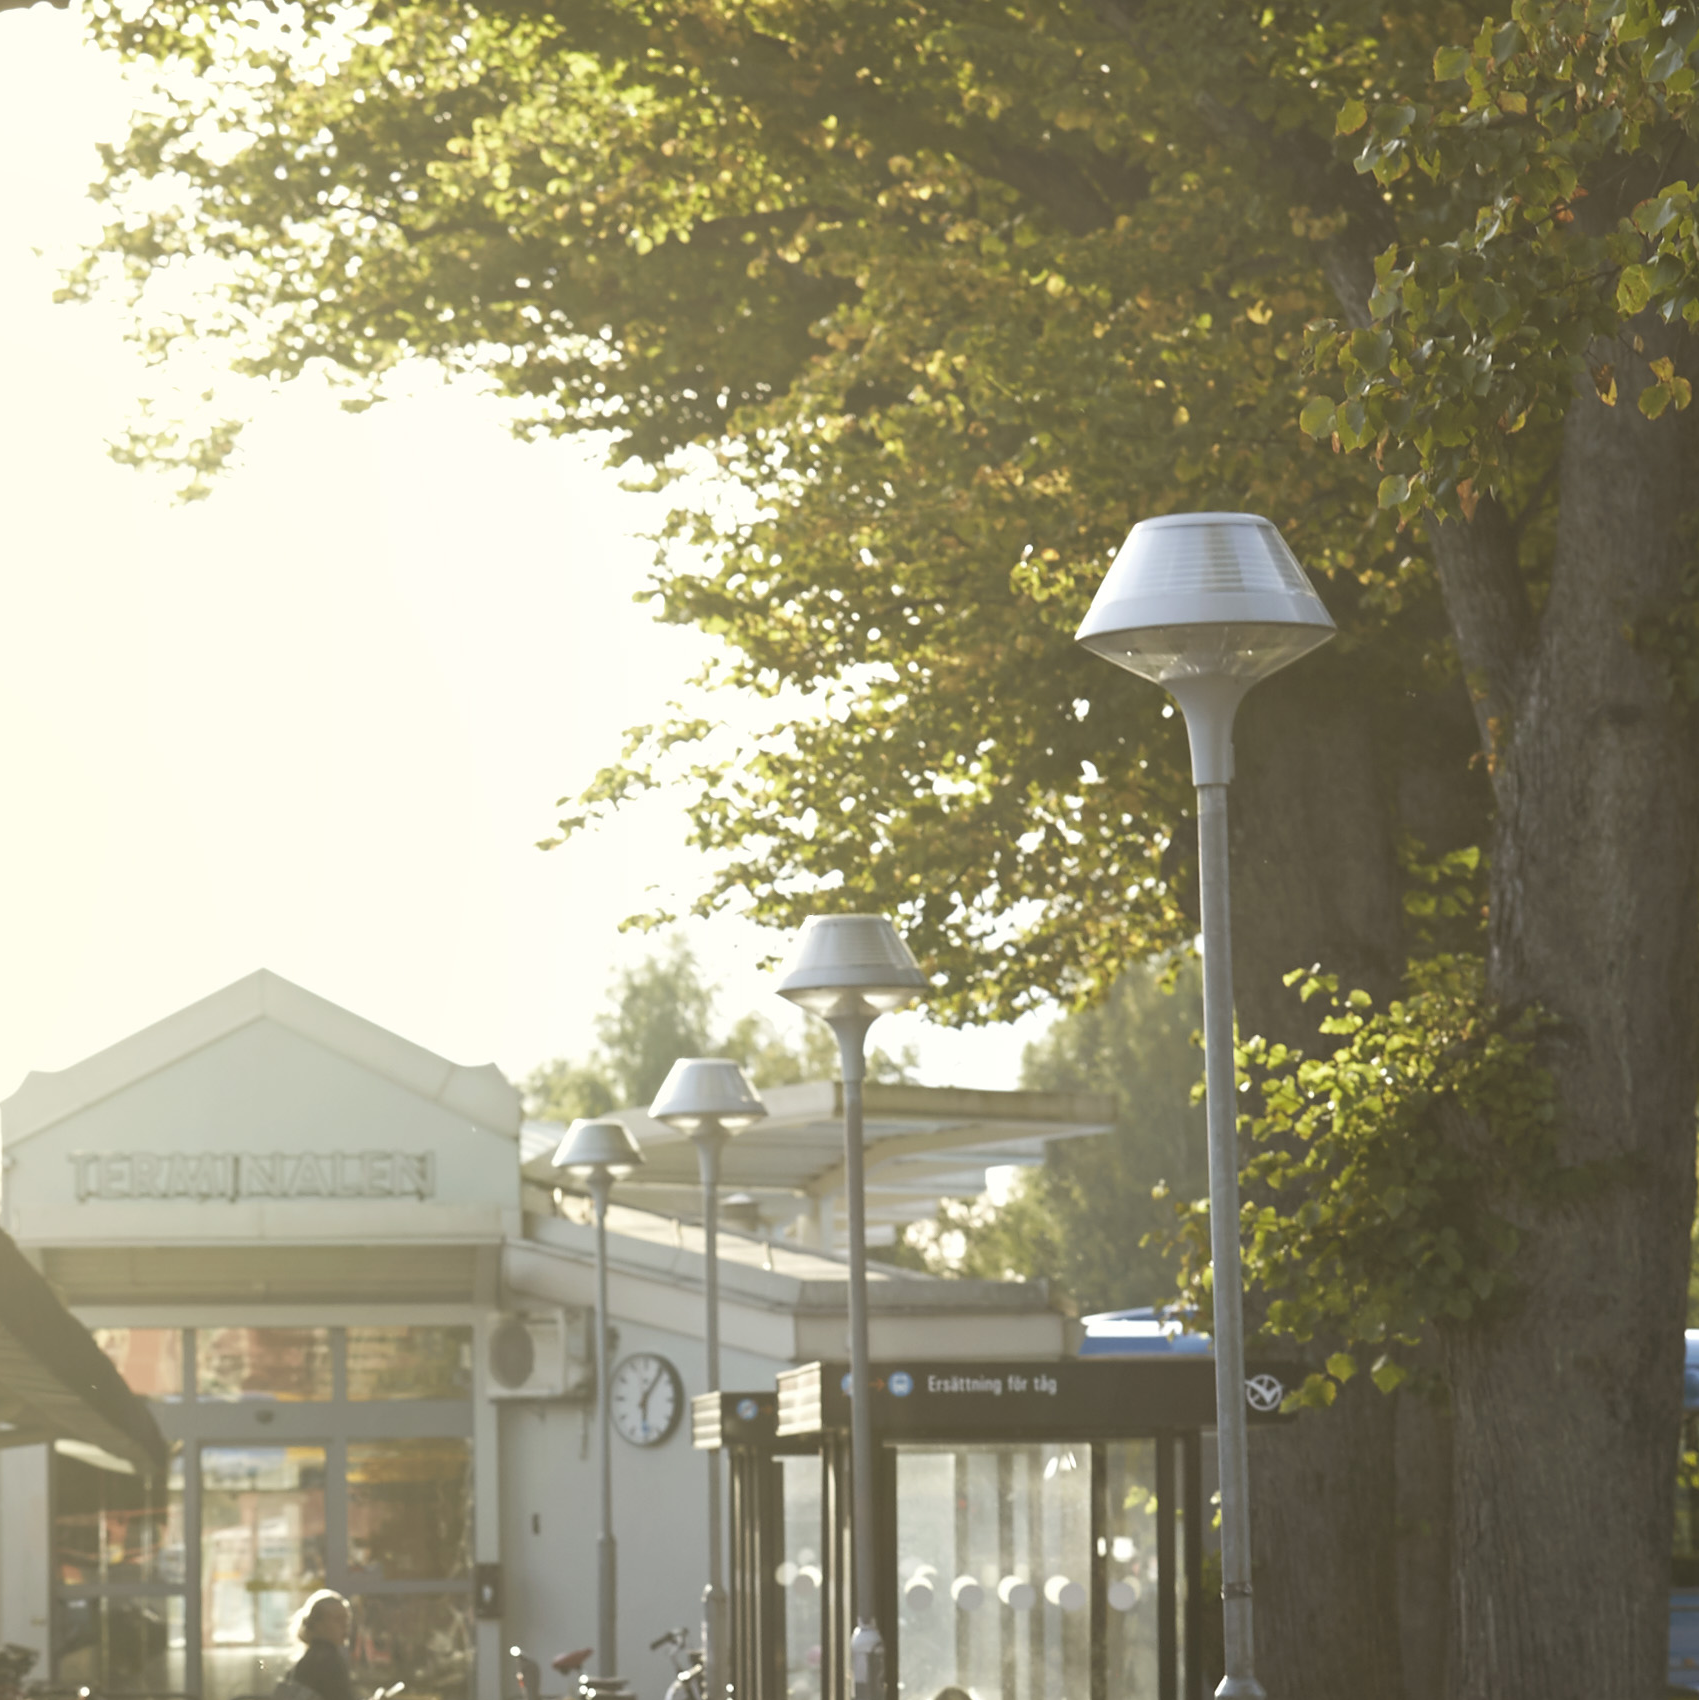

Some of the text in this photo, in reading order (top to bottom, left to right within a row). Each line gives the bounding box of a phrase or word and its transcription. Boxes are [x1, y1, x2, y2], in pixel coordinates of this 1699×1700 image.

[68, 1150, 436, 1201] TERMINALEN
[927, 1373, 1057, 1396] Ersättning för tåg
